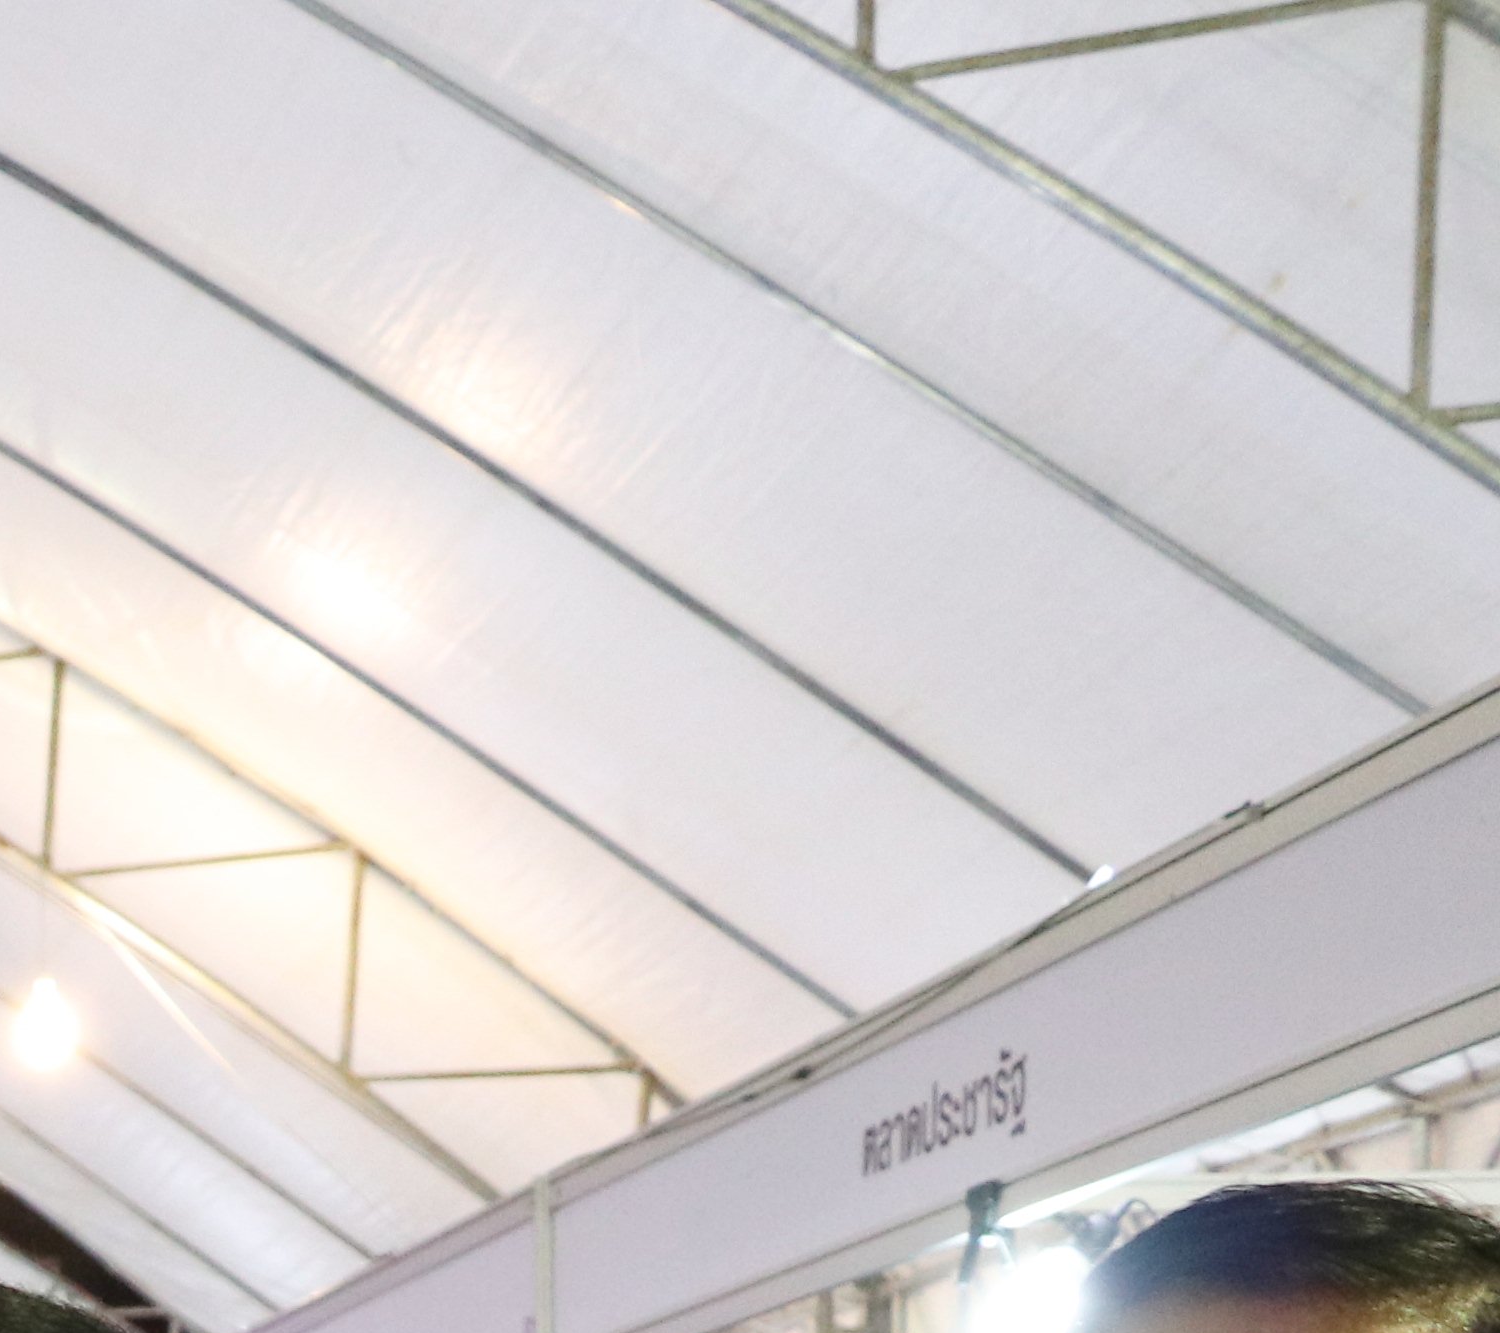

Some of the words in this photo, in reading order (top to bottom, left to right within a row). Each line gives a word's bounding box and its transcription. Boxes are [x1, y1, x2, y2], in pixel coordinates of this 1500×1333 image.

[861, 1048, 1027, 1176] ตลาดประชารัฐ
